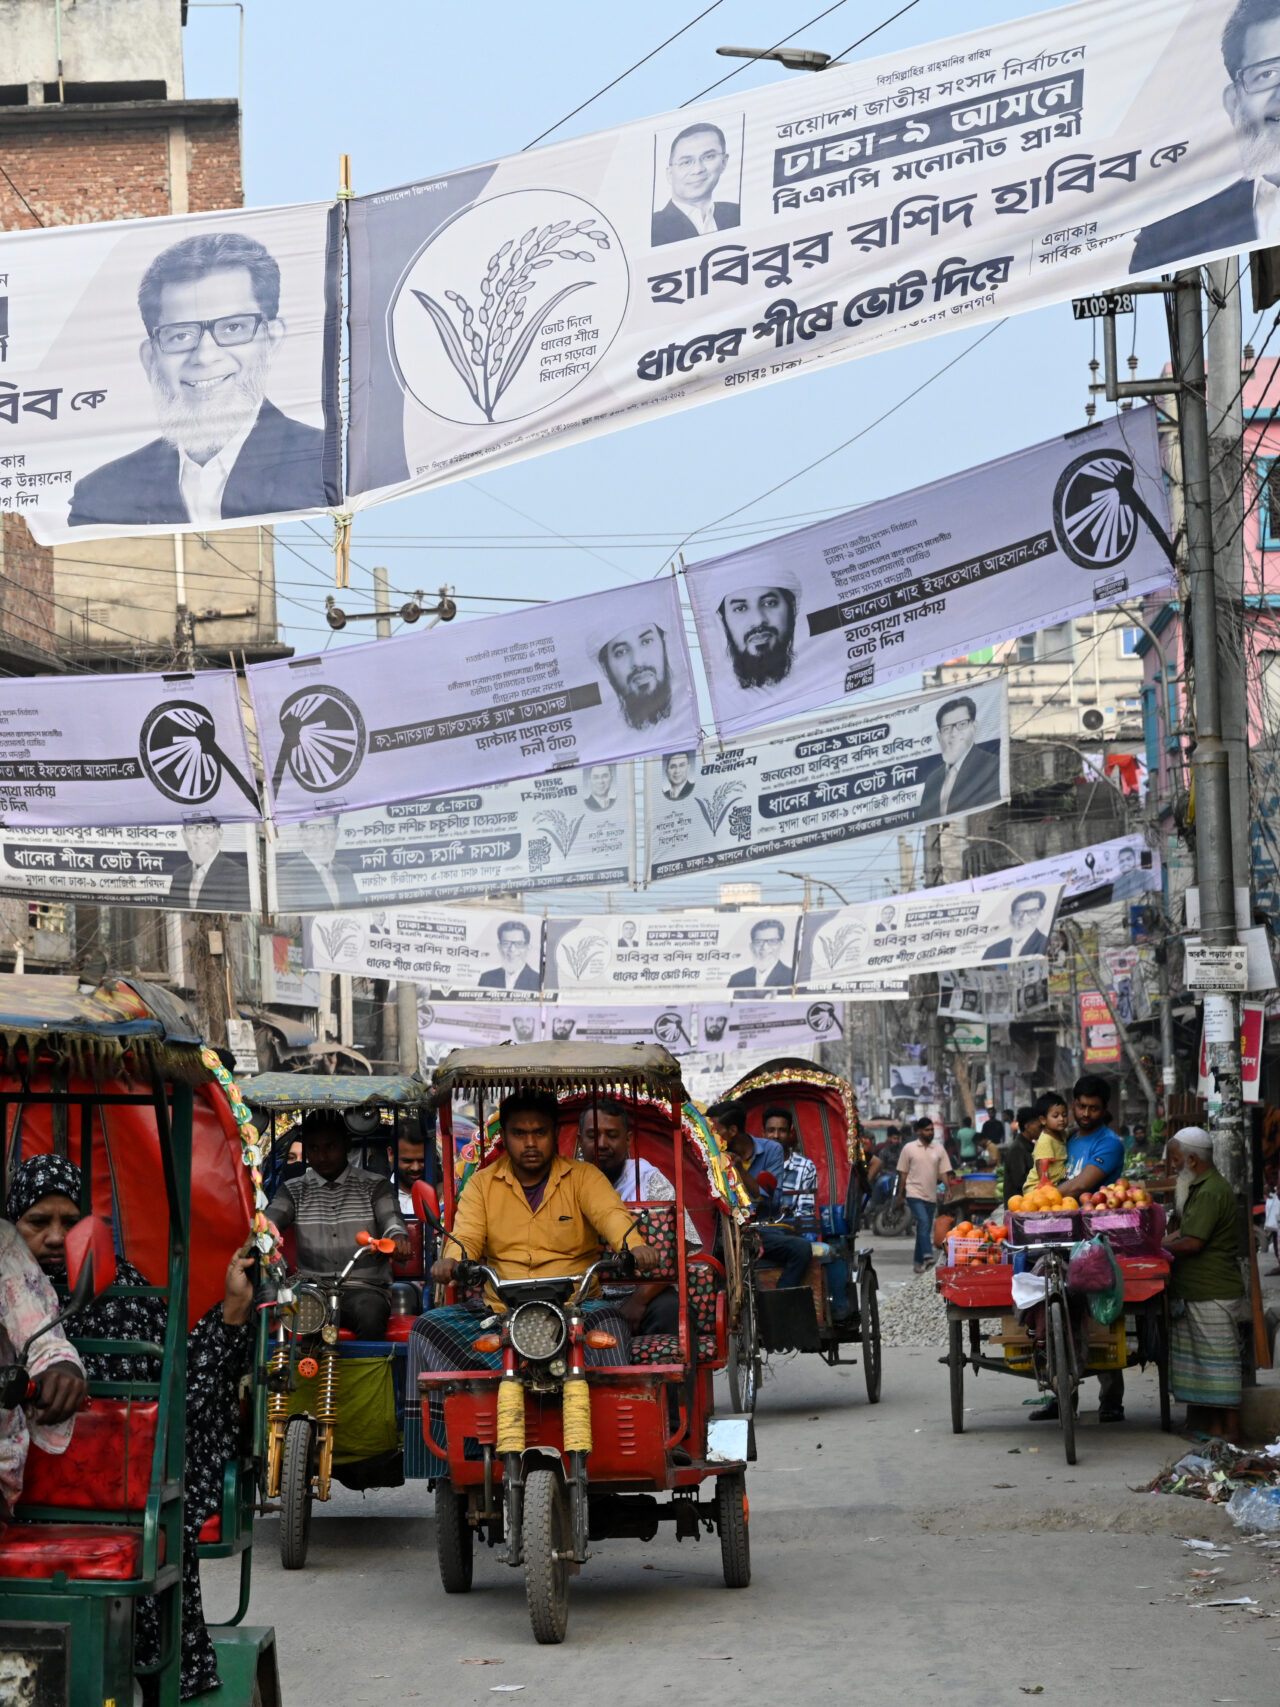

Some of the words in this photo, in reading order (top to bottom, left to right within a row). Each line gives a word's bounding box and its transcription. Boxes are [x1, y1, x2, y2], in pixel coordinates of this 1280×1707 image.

[776, 105, 857, 138] ত্রয়োদশ
[863, 86, 931, 115] জাতীয়
[936, 69, 996, 95] সংসদ
[1001, 45, 1086, 80] নির্বাচনে
[782, 120, 930, 176] ঢাকা-৯
[950, 79, 1073, 131] আসনে
[772, 167, 880, 214] বিএনপি
[892, 137, 1007, 180] মনোনীত
[1020, 111, 1081, 151] প্রার্থী
[647, 231, 832, 304] হাবিবুর
[847, 193, 977, 252] রশিদ
[991, 149, 1141, 214] হাবিব
[1150, 140, 1188, 169] কে
[637, 327, 746, 380] ধানের
[752, 300, 837, 348] শীষে
[843, 270, 927, 327] ভোট
[931, 256, 1014, 301] দিয়ে
[1073, 296, 1133, 317] 7109-28
[541, 319, 564, 335] ভোট
[567, 315, 592, 329] দিলে
[541, 335, 571, 350] ধানের
[574, 329, 599, 341] শীষে
[541, 353, 561, 366] দেশ
[564, 345, 596, 360] গড়বো
[539, 362, 590, 382] মিলেমিশে
[71, 389, 107, 410] কে
[15, 470, 72, 486] উন্নয়নের
[842, 593, 891, 618] জননেতা
[895, 584, 919, 599] শাহ
[922, 562, 980, 591] ইফতেখার
[845, 613, 900, 641] হাতপাখা
[902, 598, 945, 622] মার্কায়
[847, 638, 876, 658] ভোট
[879, 630, 904, 648] দিন
[799, 738, 841, 757] ঢাকা-৯
[846, 727, 887, 744] আসনে
[701, 756, 757, 776] বাংলাদেশ
[769, 791, 810, 812] ধানের
[814, 782, 848, 801] শীষে
[854, 773, 887, 794] ভোট
[891, 766, 918, 785] দিন
[14, 850, 55, 865] ধানের
[59, 851, 94, 867] শীষে
[100, 852, 133, 869] ভোট
[136, 852, 163, 870] দিন
